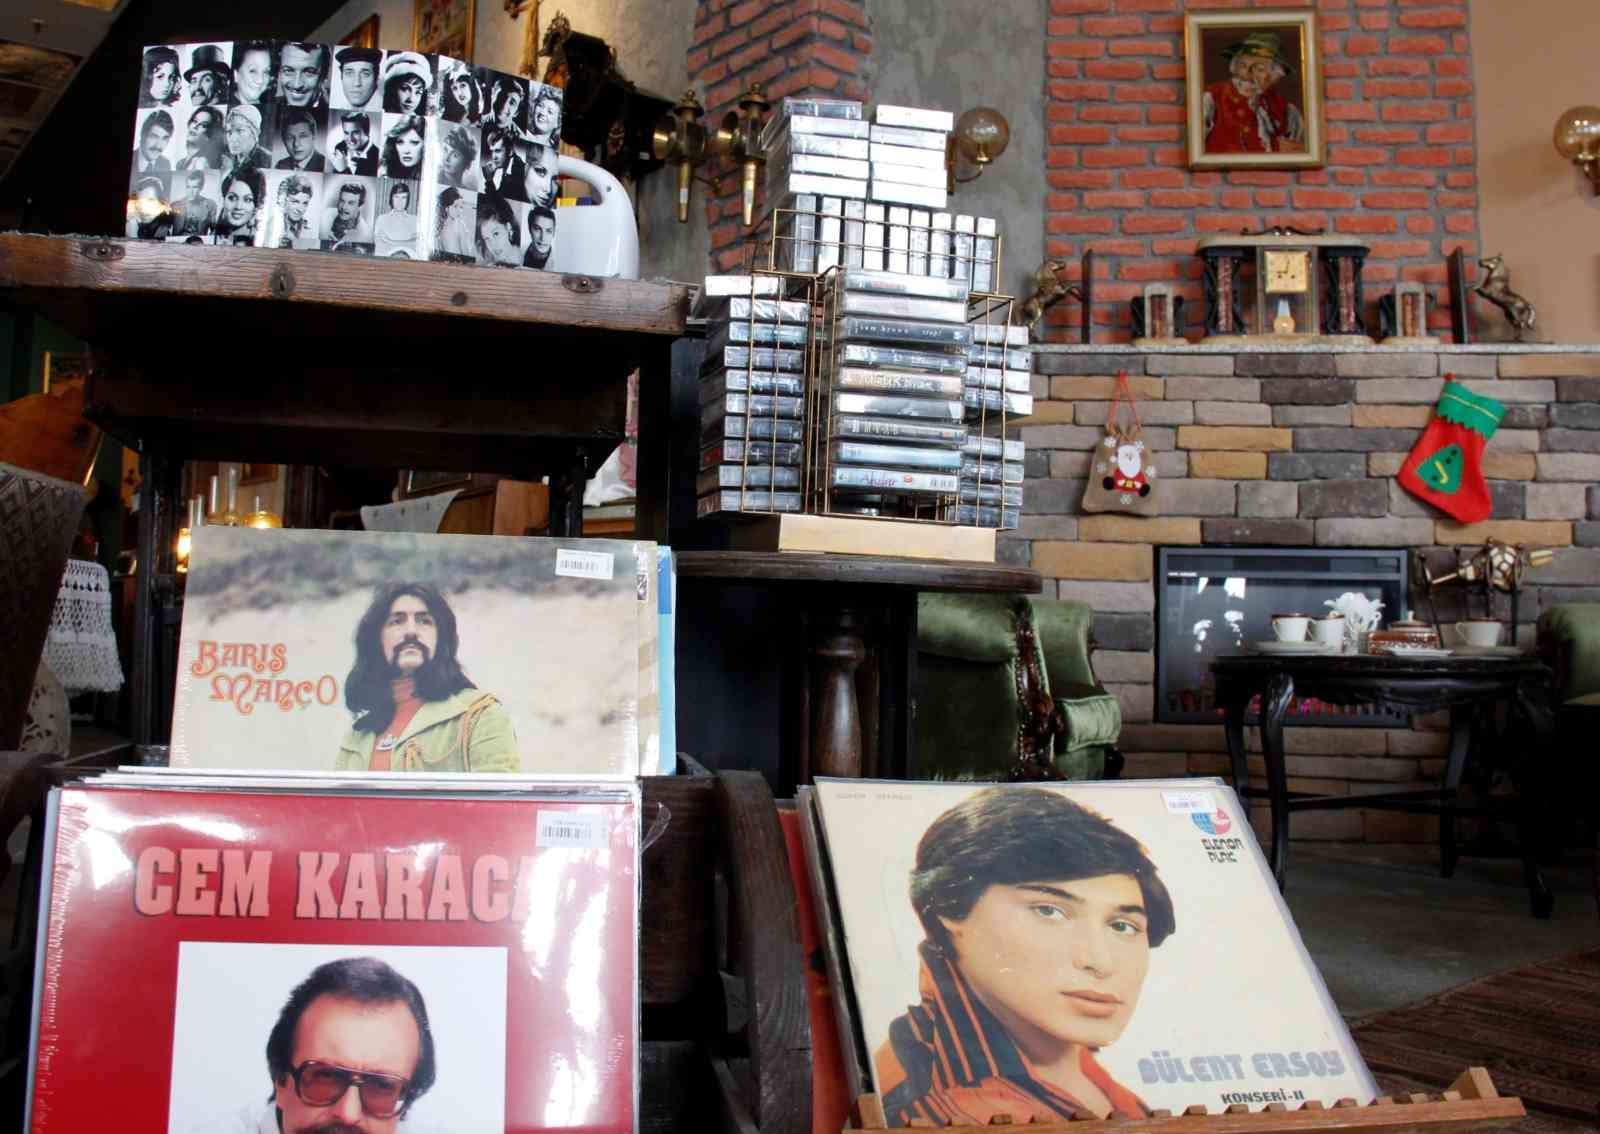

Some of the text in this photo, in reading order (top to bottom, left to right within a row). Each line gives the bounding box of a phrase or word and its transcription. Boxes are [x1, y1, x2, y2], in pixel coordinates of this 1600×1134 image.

[135, 846, 273, 917] CEM
[1137, 1049, 1345, 1084] BÜLENT ERSOY
